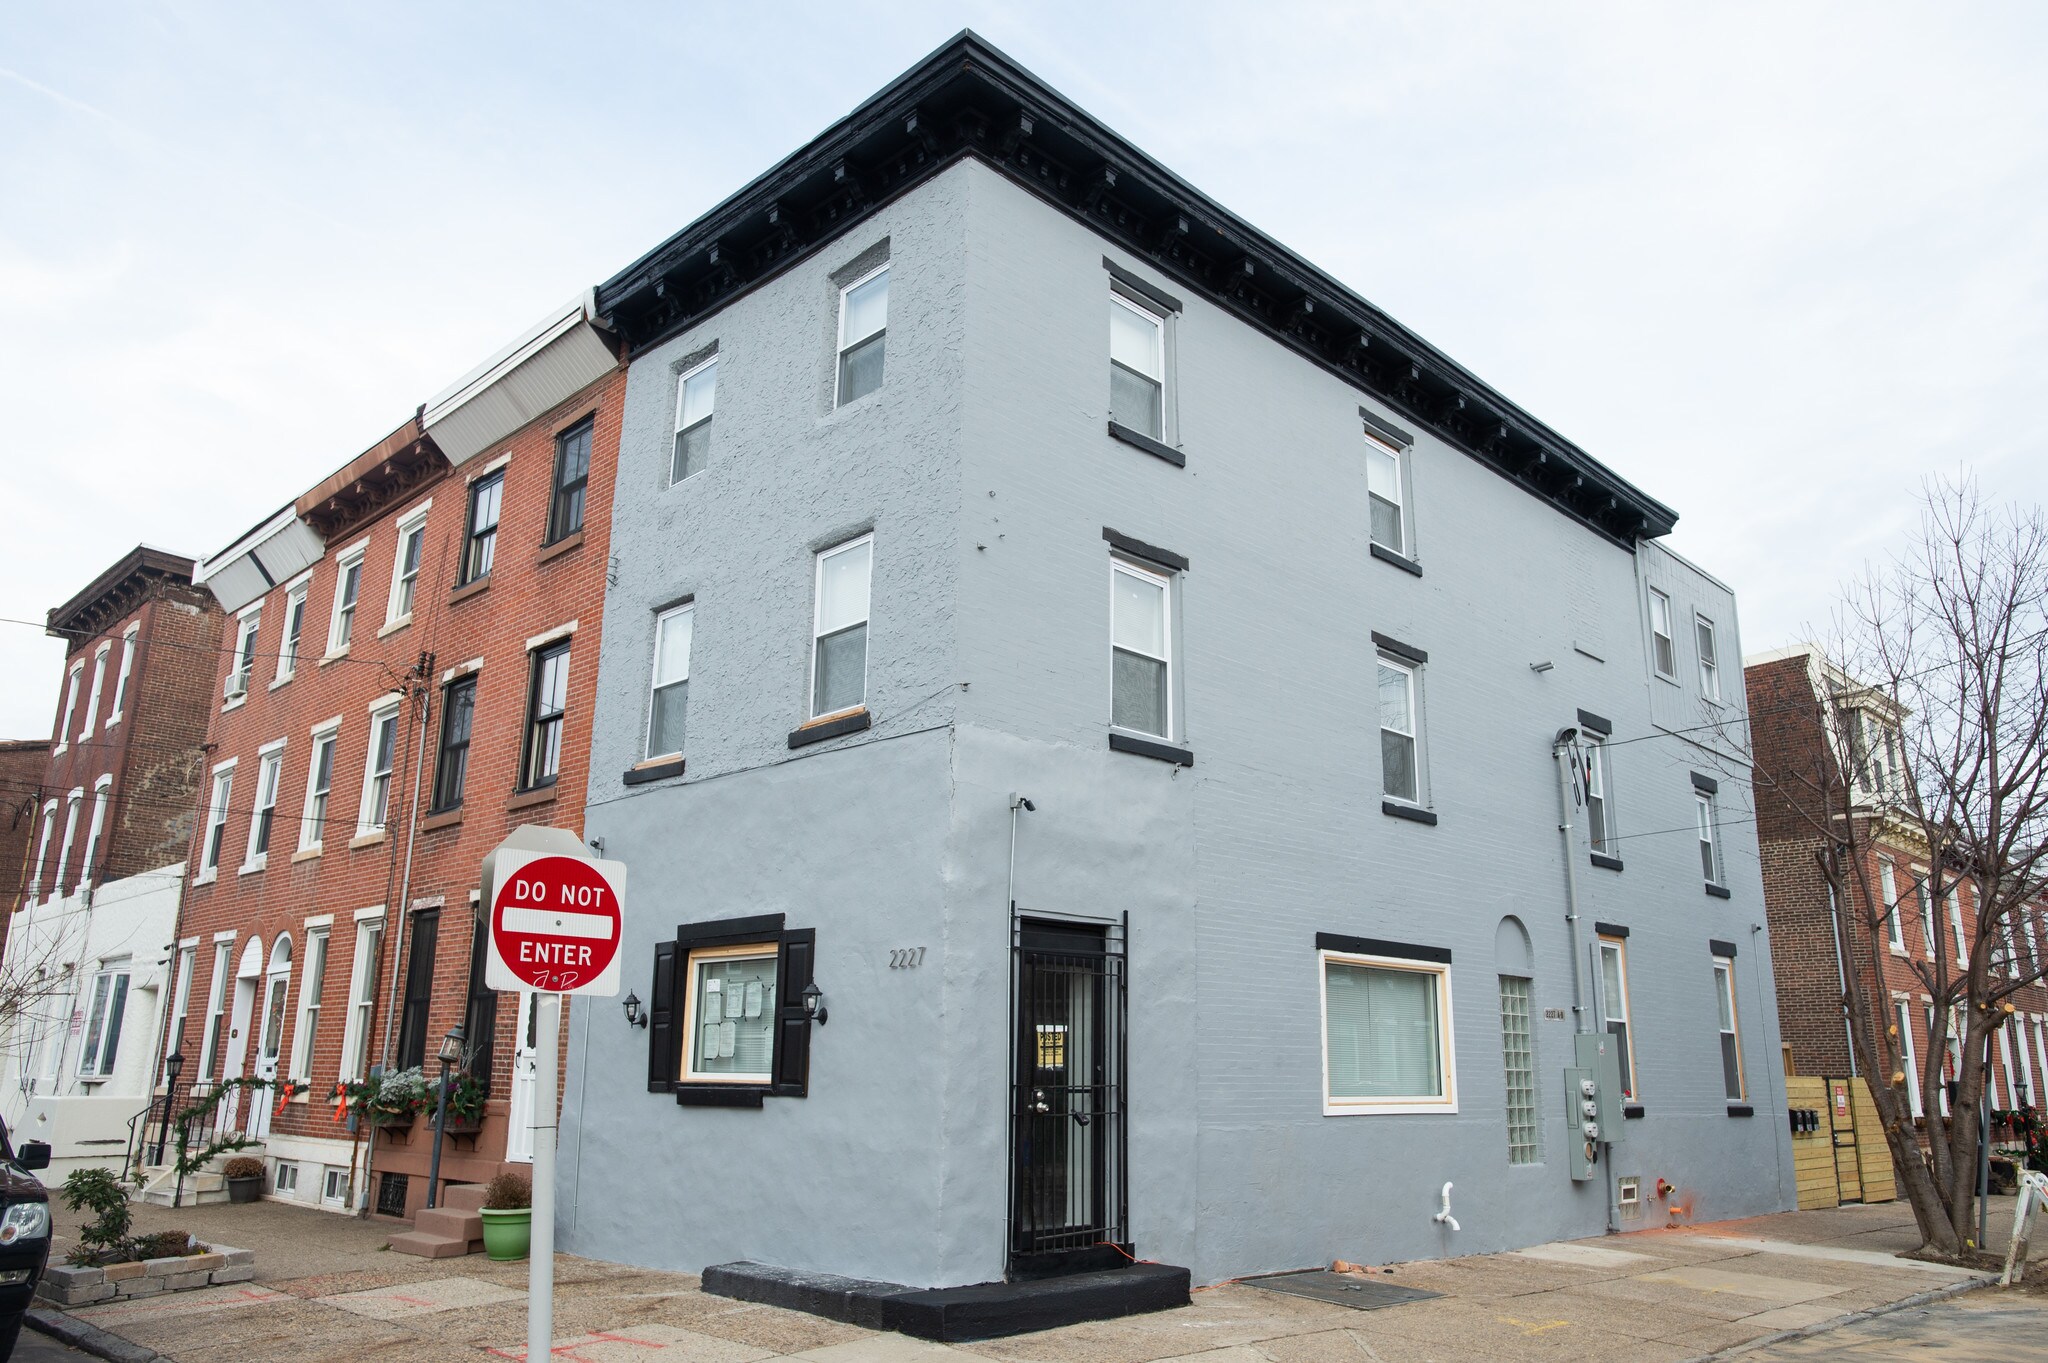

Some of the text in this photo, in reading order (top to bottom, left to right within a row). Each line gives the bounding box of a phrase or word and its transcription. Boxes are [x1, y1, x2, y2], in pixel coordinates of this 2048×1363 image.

[515, 879, 605, 908] DO NOT
[519, 941, 592, 966] ENTER
[889, 946, 927, 970] 2227
